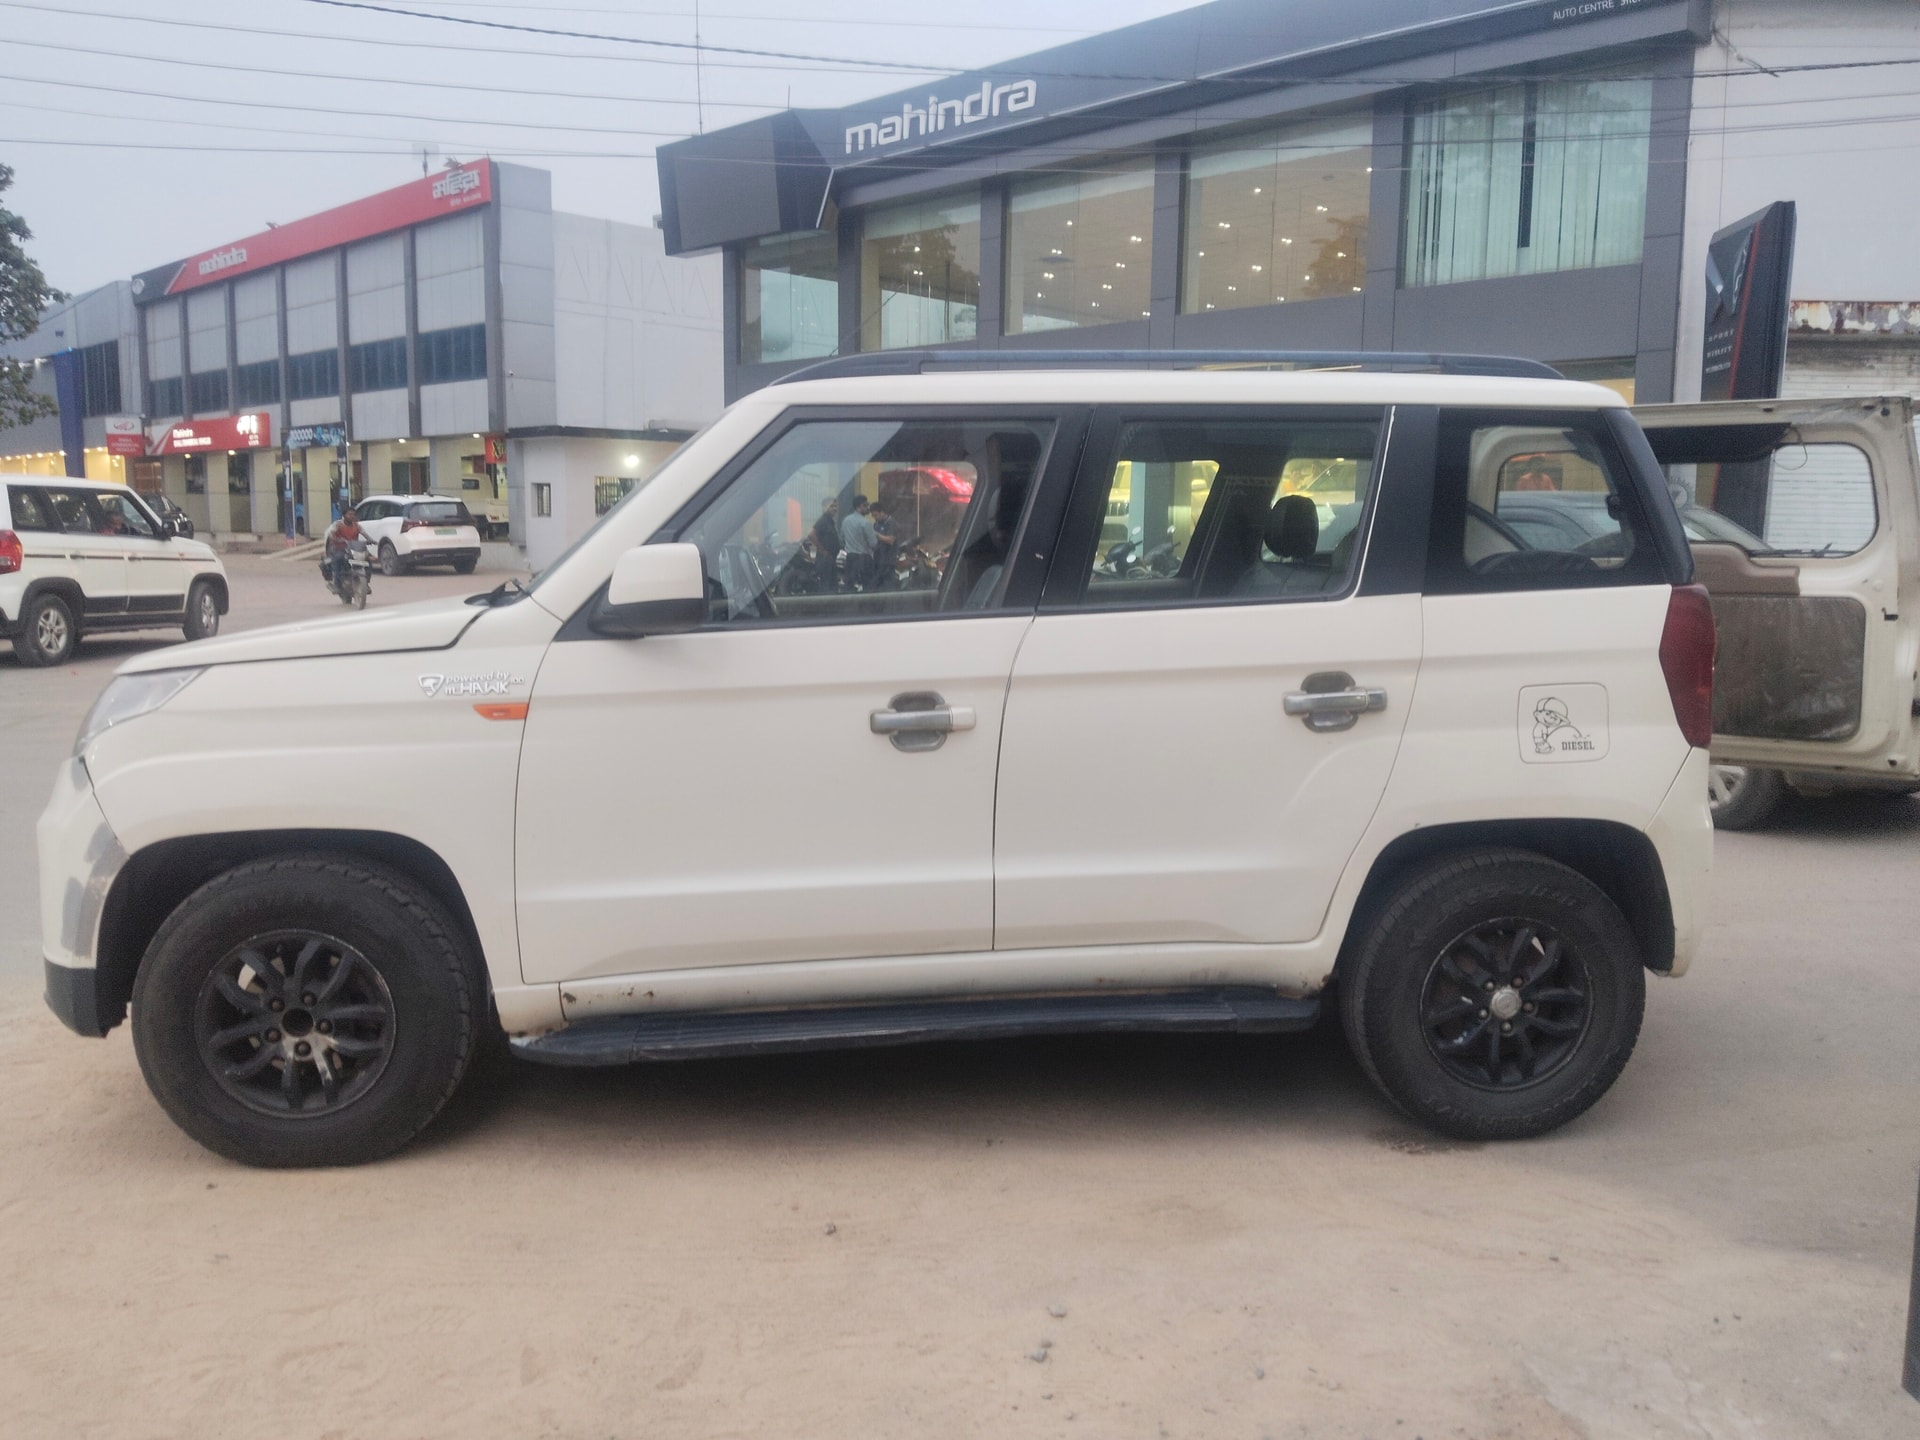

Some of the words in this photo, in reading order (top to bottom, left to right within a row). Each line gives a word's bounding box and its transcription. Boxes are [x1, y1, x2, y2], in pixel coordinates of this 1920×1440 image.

[1552, 7, 1577, 20] AUTO
[1578, 0, 1614, 15] CENTRE
[845, 79, 1037, 154] mahindra
[198, 247, 248, 275] mahindra
[446, 672, 493, 685] powered
[496, 671, 511, 681] by
[1561, 741, 1595, 751] DIESEL
